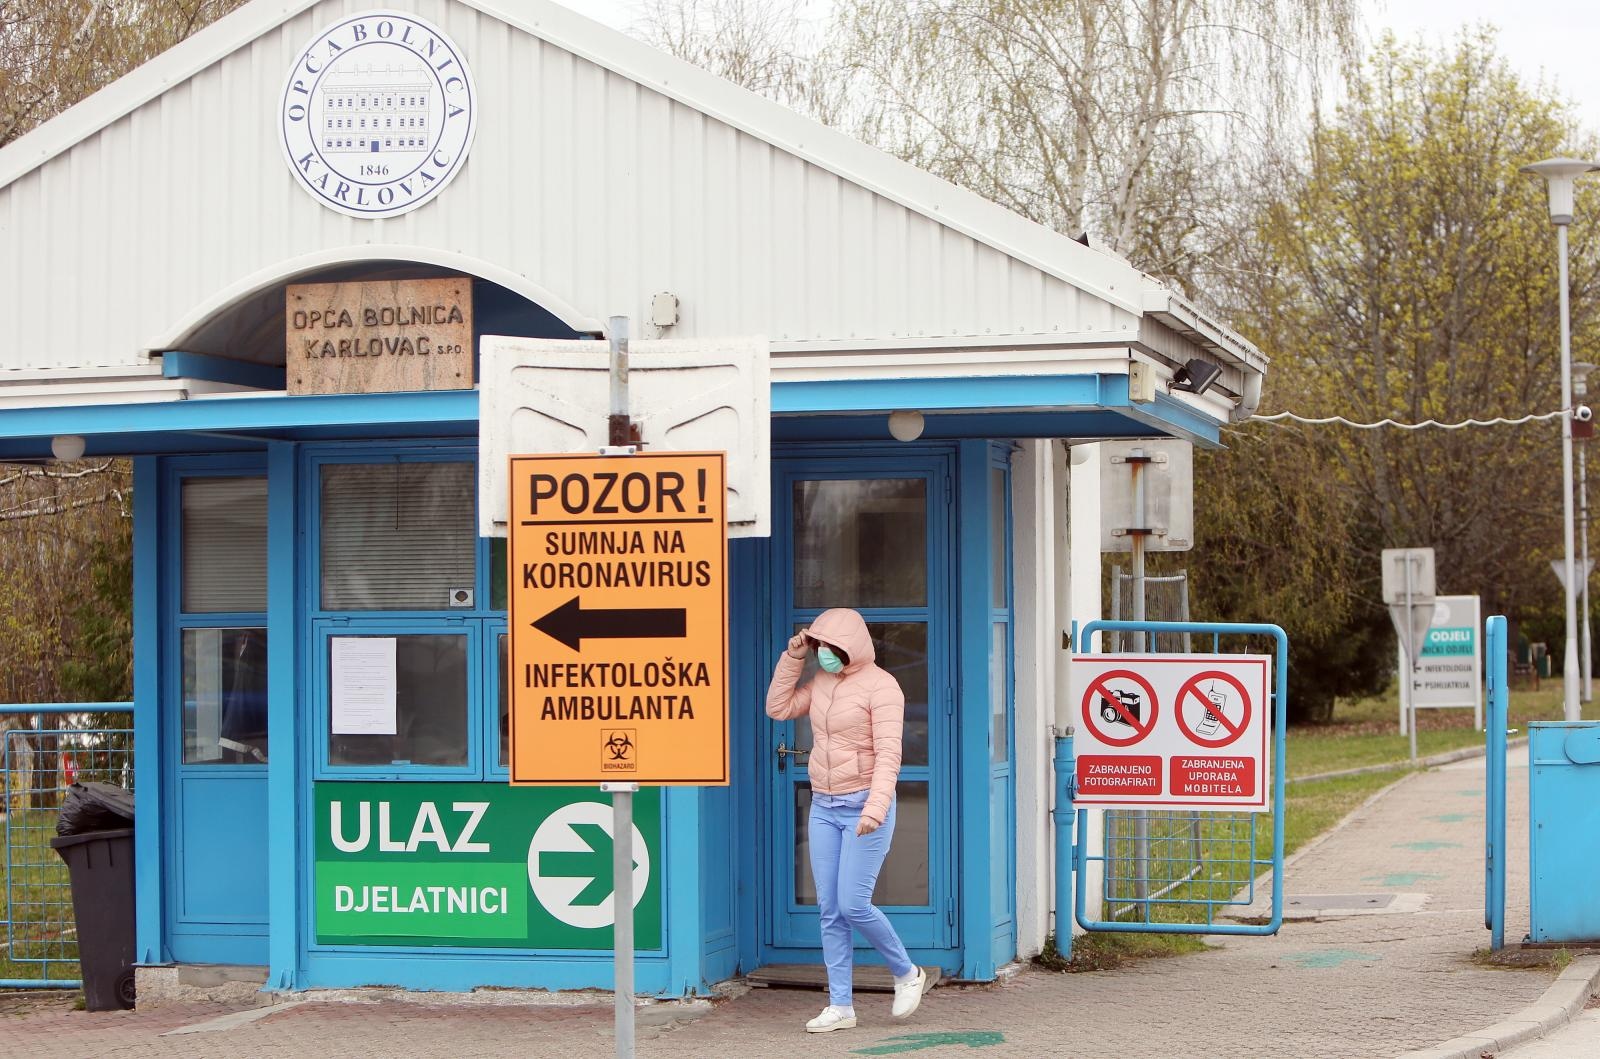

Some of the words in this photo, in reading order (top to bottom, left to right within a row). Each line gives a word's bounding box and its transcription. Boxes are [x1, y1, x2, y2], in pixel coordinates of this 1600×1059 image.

[352, 21, 465, 119] BOLNICA
[298, 149, 450, 206] KARLOVAC
[359, 164, 389, 176] 1846
[363, 304, 464, 327] BOLNICA
[304, 336, 431, 359] KARLOVAC
[545, 530, 645, 556] SUMNJA
[653, 530, 686, 554] NA
[522, 560, 711, 589] KORONAVIRUS
[1430, 630, 1471, 642] ODJELI
[525, 656, 711, 688] INFEKTOLOŠKA
[540, 695, 695, 721] AMBULANTA
[1088, 765, 1152, 775] ZABRANJENO
[1181, 759, 1245, 769] ZABRANJENA
[1084, 777, 1156, 787] FOTOGRAFIRATI
[1188, 772, 1238, 781] UPORABA
[1184, 784, 1242, 794] MOBITELA
[330, 801, 491, 853] ULAZ
[335, 885, 507, 914] DJELATNICI
